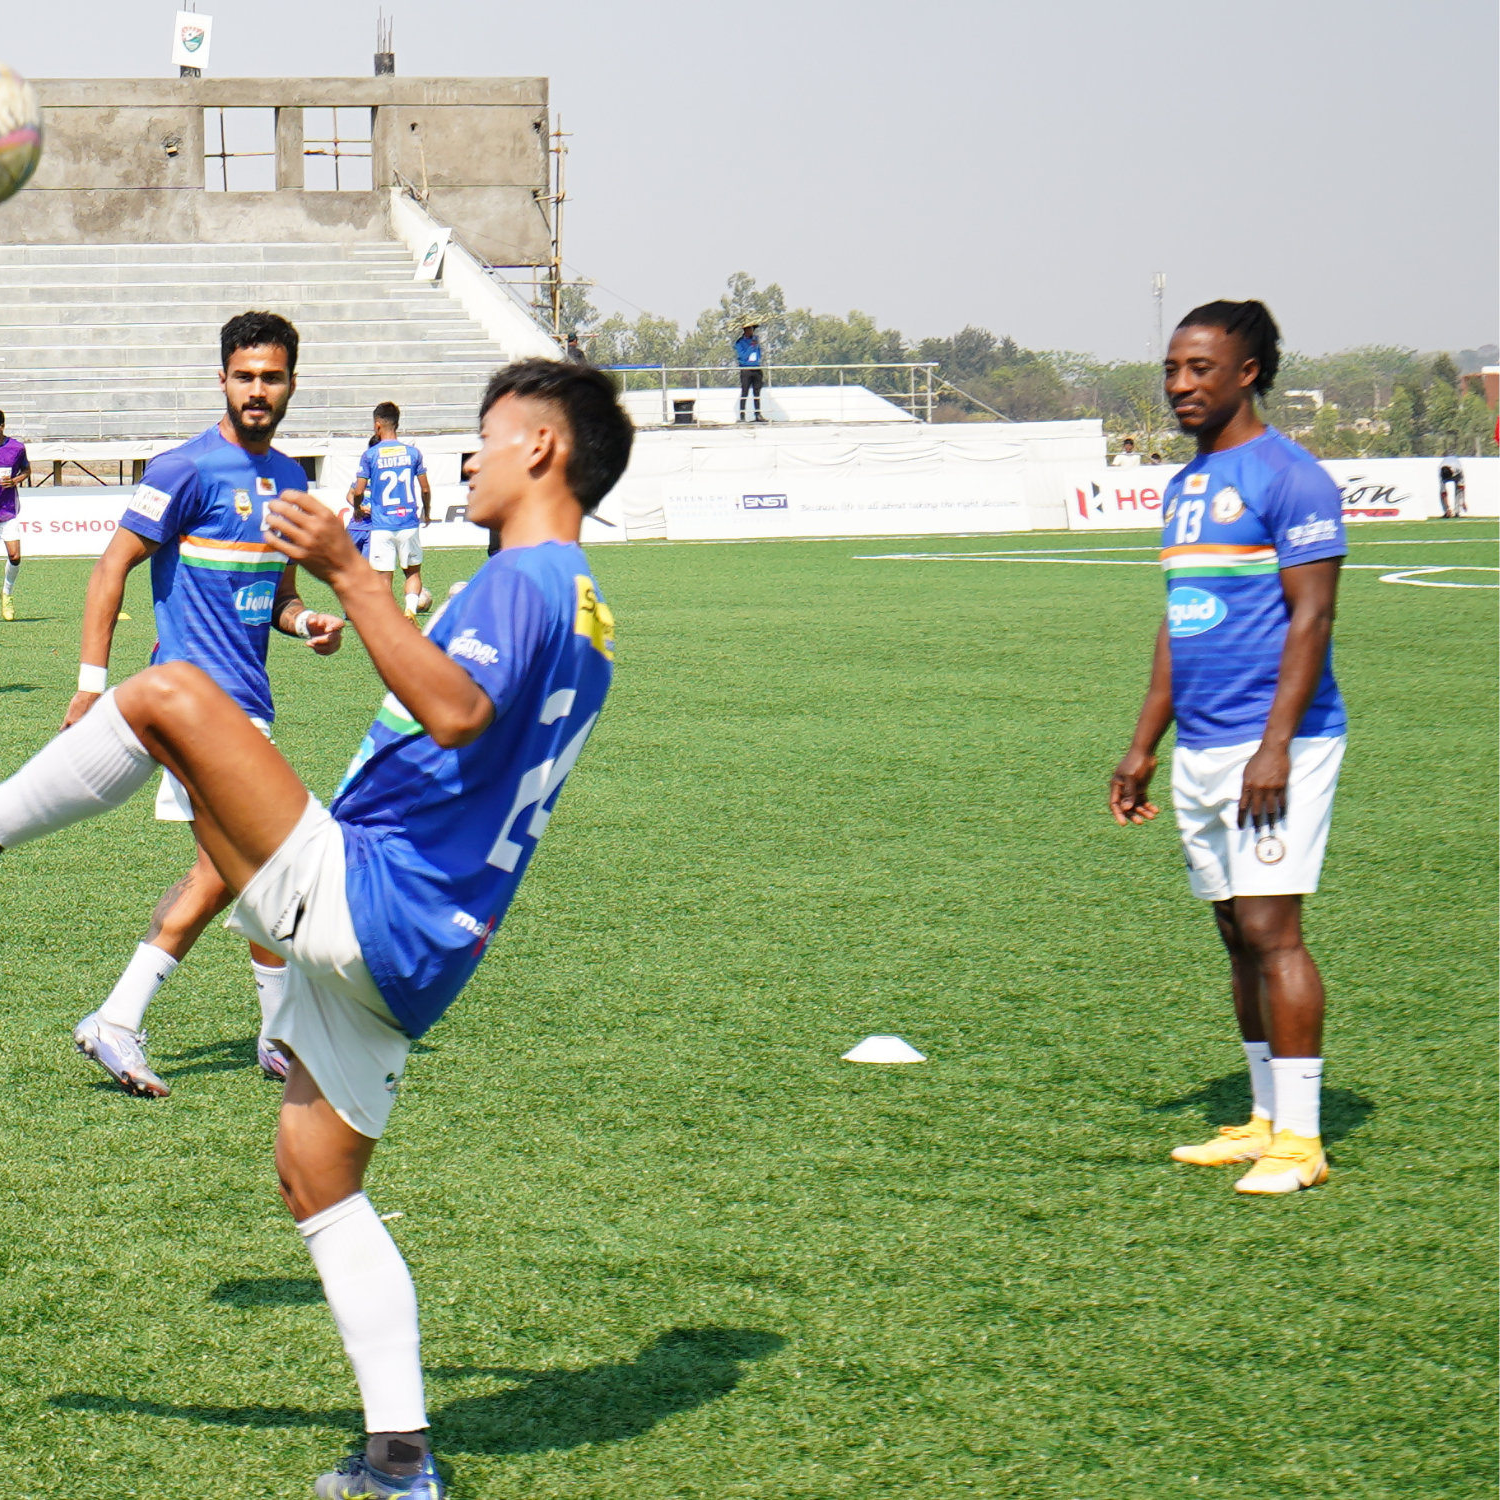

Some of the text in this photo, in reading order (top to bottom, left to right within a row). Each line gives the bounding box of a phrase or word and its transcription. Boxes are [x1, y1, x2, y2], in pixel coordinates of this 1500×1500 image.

[379, 467, 415, 507] 21
[1115, 487, 1161, 511] He
[744, 496, 788, 508] SNIST
[49, 519, 118, 533] SCHOO
[1175, 499, 1206, 545] 13
